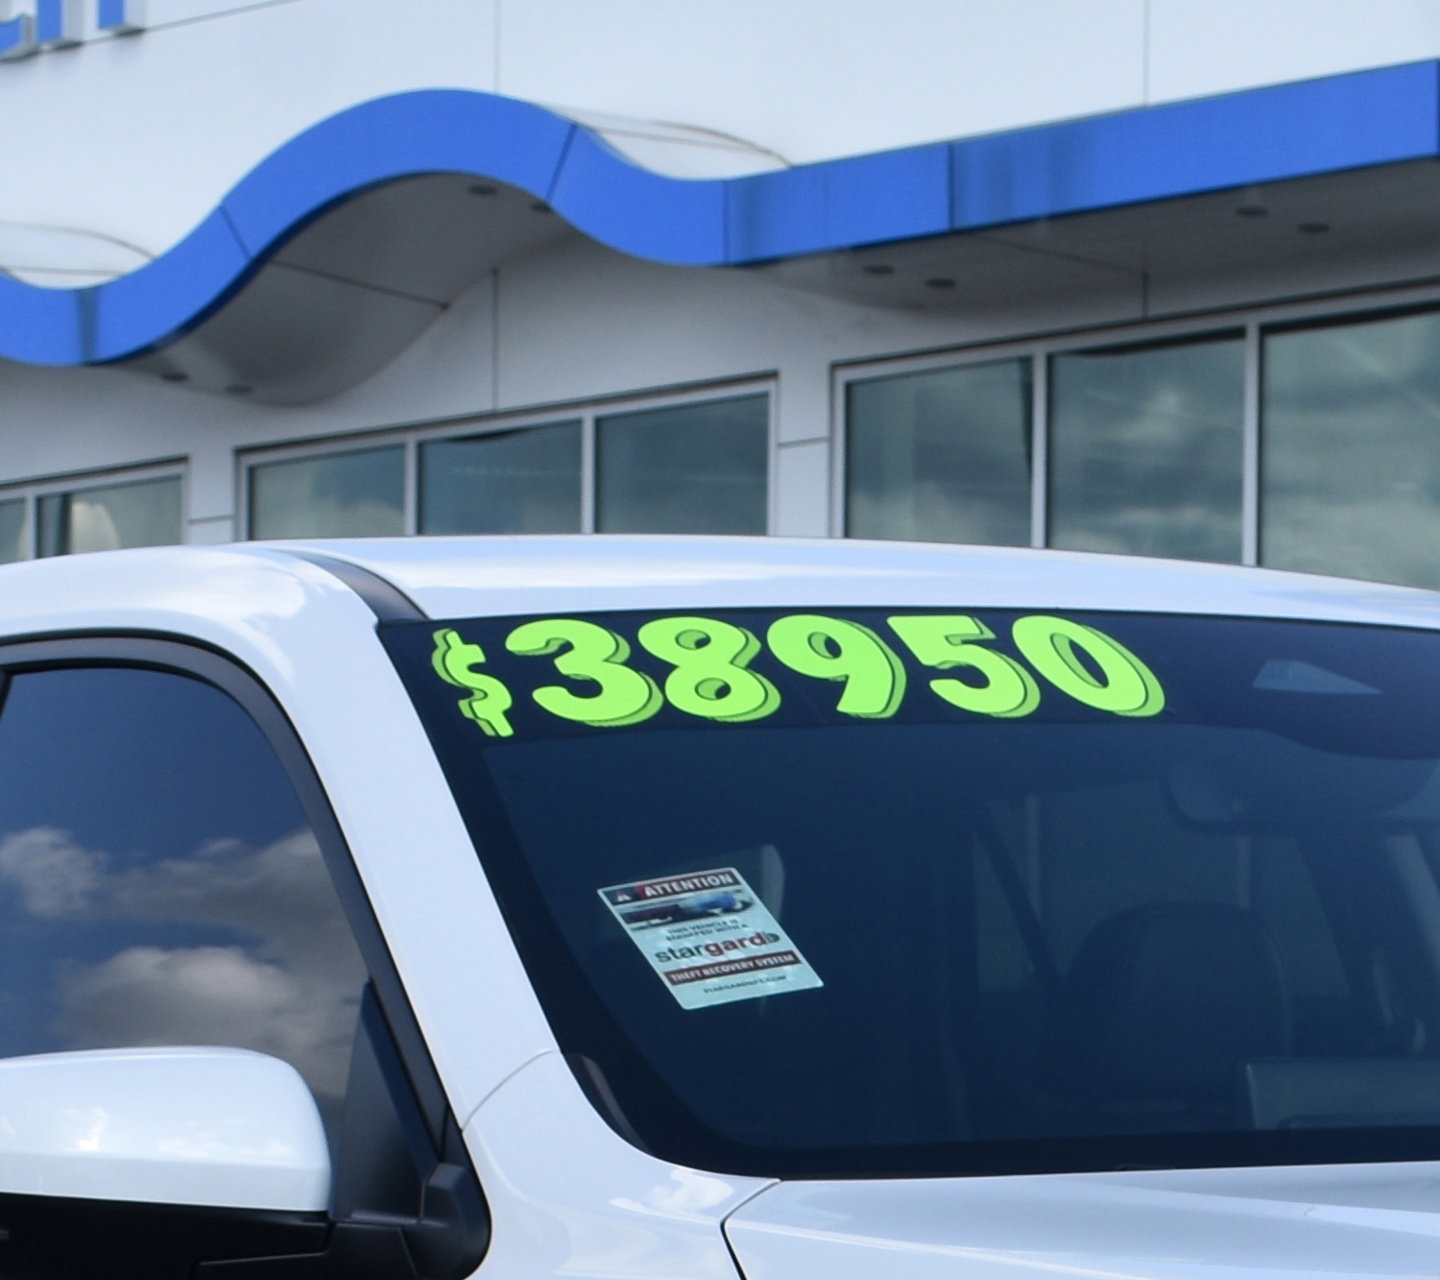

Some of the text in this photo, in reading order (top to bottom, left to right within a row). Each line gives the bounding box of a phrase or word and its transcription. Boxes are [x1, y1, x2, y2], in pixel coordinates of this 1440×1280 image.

[431, 613, 1166, 737] $38950
[643, 872, 735, 898] ATTENTION
[654, 931, 768, 963] stargard
[669, 953, 796, 983] THEFT RECOVERY SYSTEM
